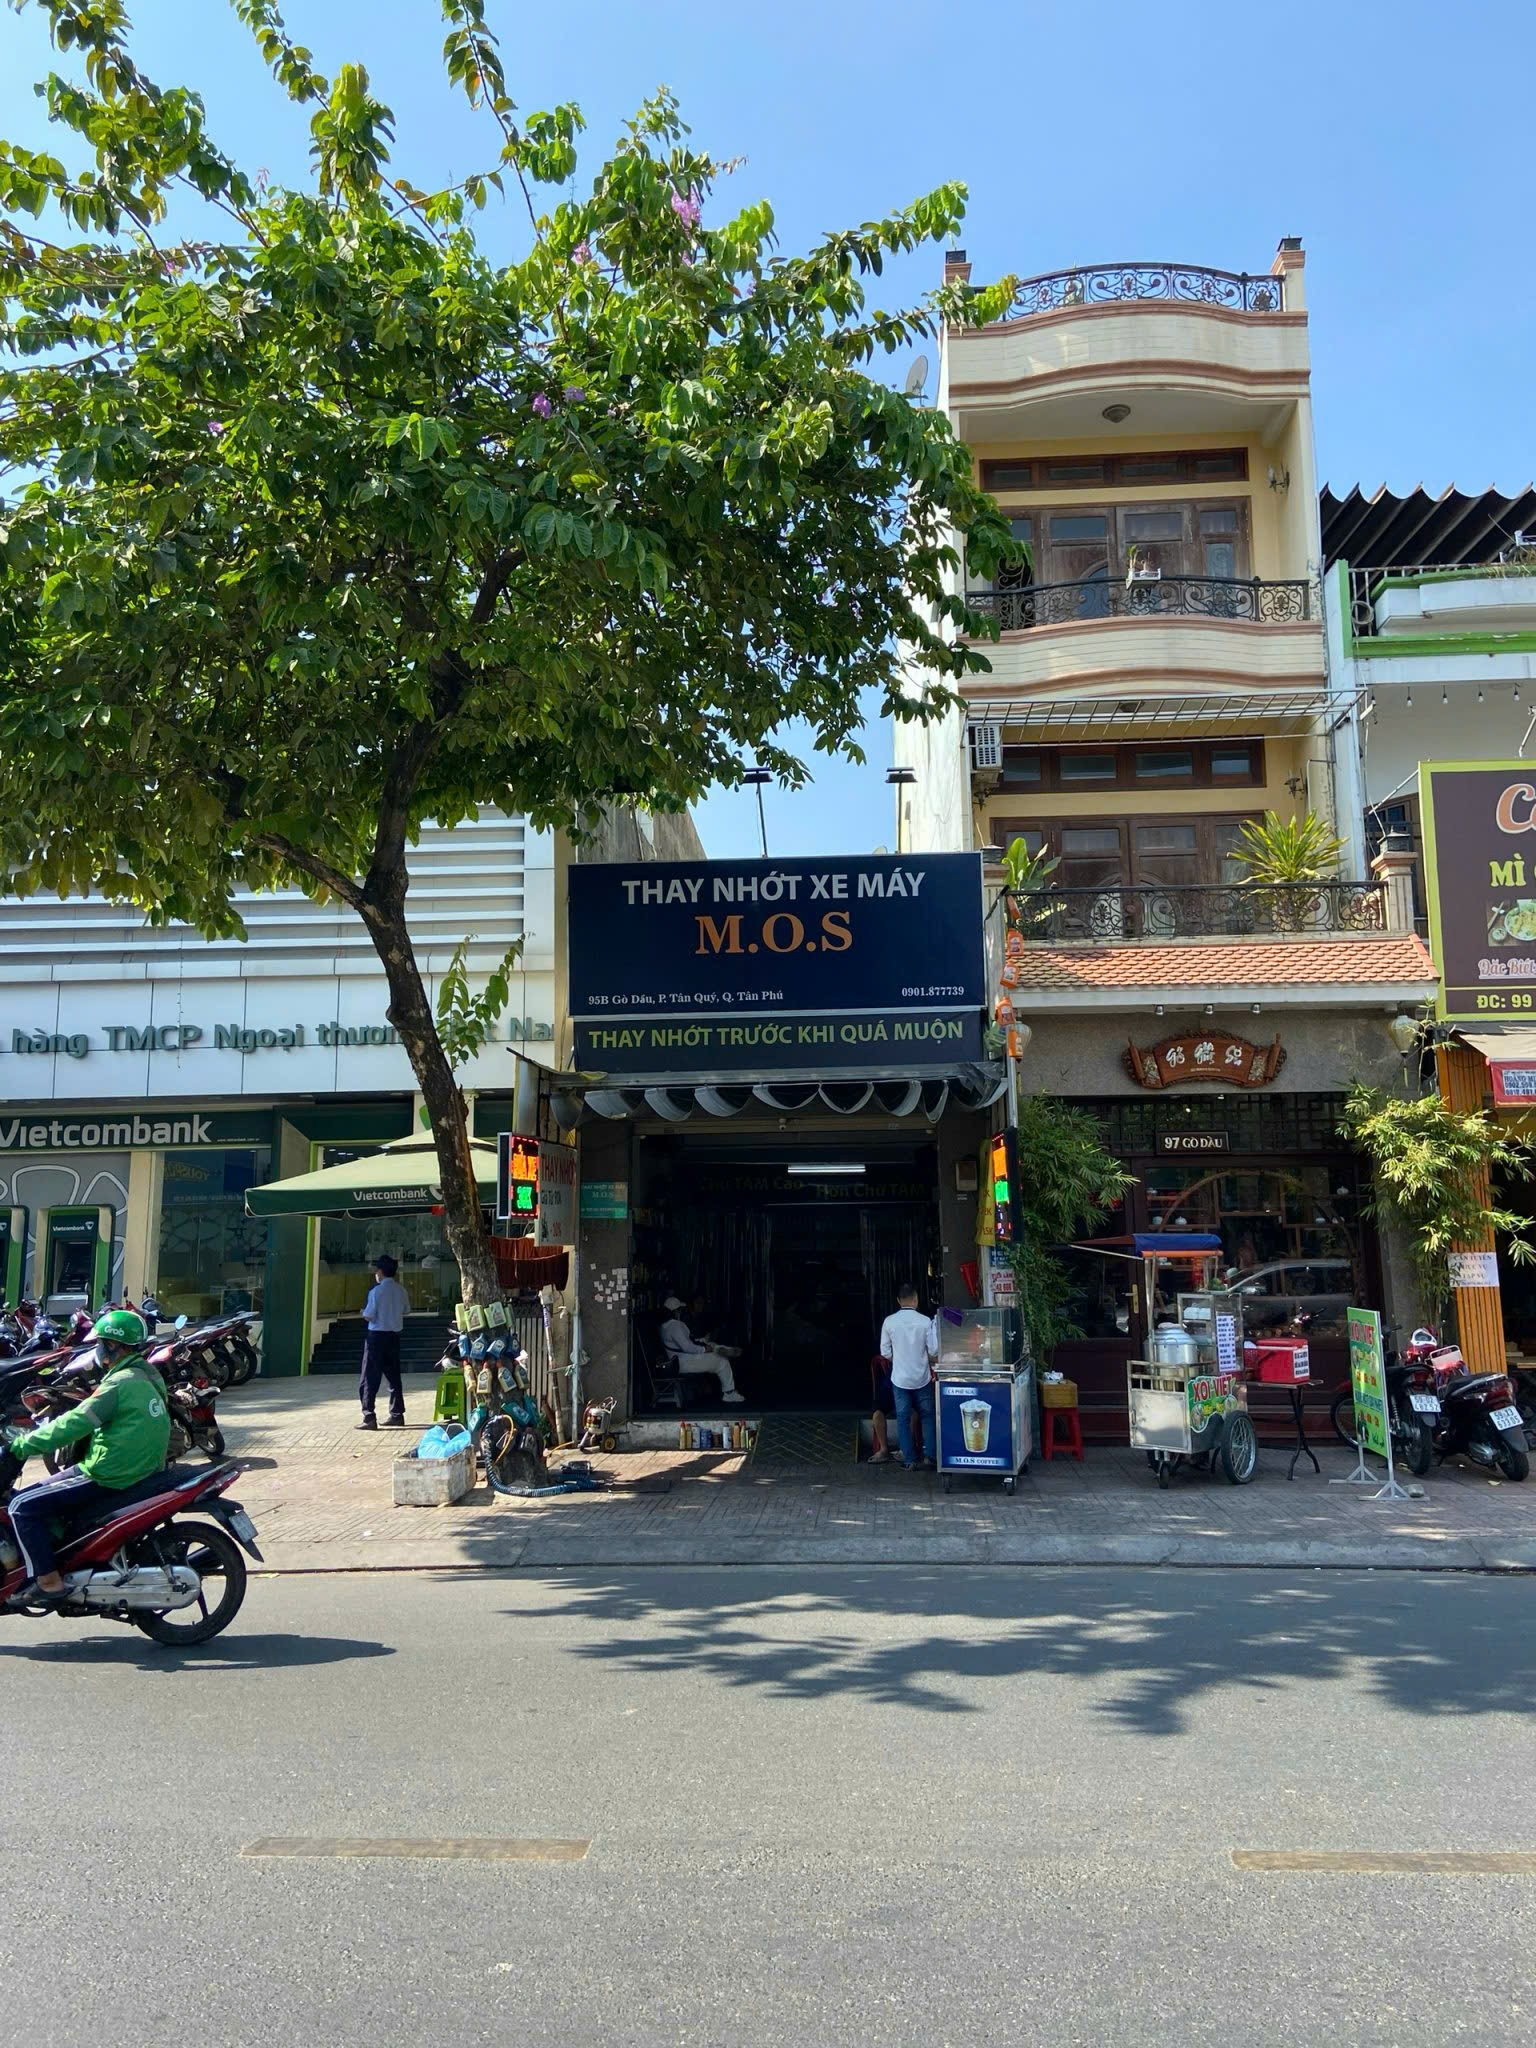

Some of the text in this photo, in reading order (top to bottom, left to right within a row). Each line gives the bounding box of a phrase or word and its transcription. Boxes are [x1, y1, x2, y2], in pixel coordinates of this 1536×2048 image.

[1489, 853, 1526, 887] MÌ
[622, 867, 925, 904] THAY NHỚT XE MÁY
[695, 911, 853, 954] M.O.S
[588, 995, 609, 1005] 95B
[612, 994, 628, 1004] Gò
[658, 993, 666, 1003] P.
[669, 992, 691, 1003] Tân
[722, 992, 734, 1002] Q.
[737, 991, 759, 1001] Tân
[761, 990, 784, 1000] Phú
[901, 986, 964, 997] 0901.877739
[1477, 993, 1532, 1009] ĐC: 99
[12, 1028, 89, 1059] hàng
[102, 1025, 203, 1051] TMCP
[214, 1023, 305, 1054] Ngoại
[315, 1021, 404, 1045] thươn
[589, 1018, 963, 1049] THAY NHỚT TRƯỚC KHI QUÁ MUỘN
[0, 1115, 213, 1148] Vietcombank
[1165, 1137, 1180, 1149] 97
[353, 1188, 428, 1202] Vietcombank
[104, 1325, 125, 1337] Grab
